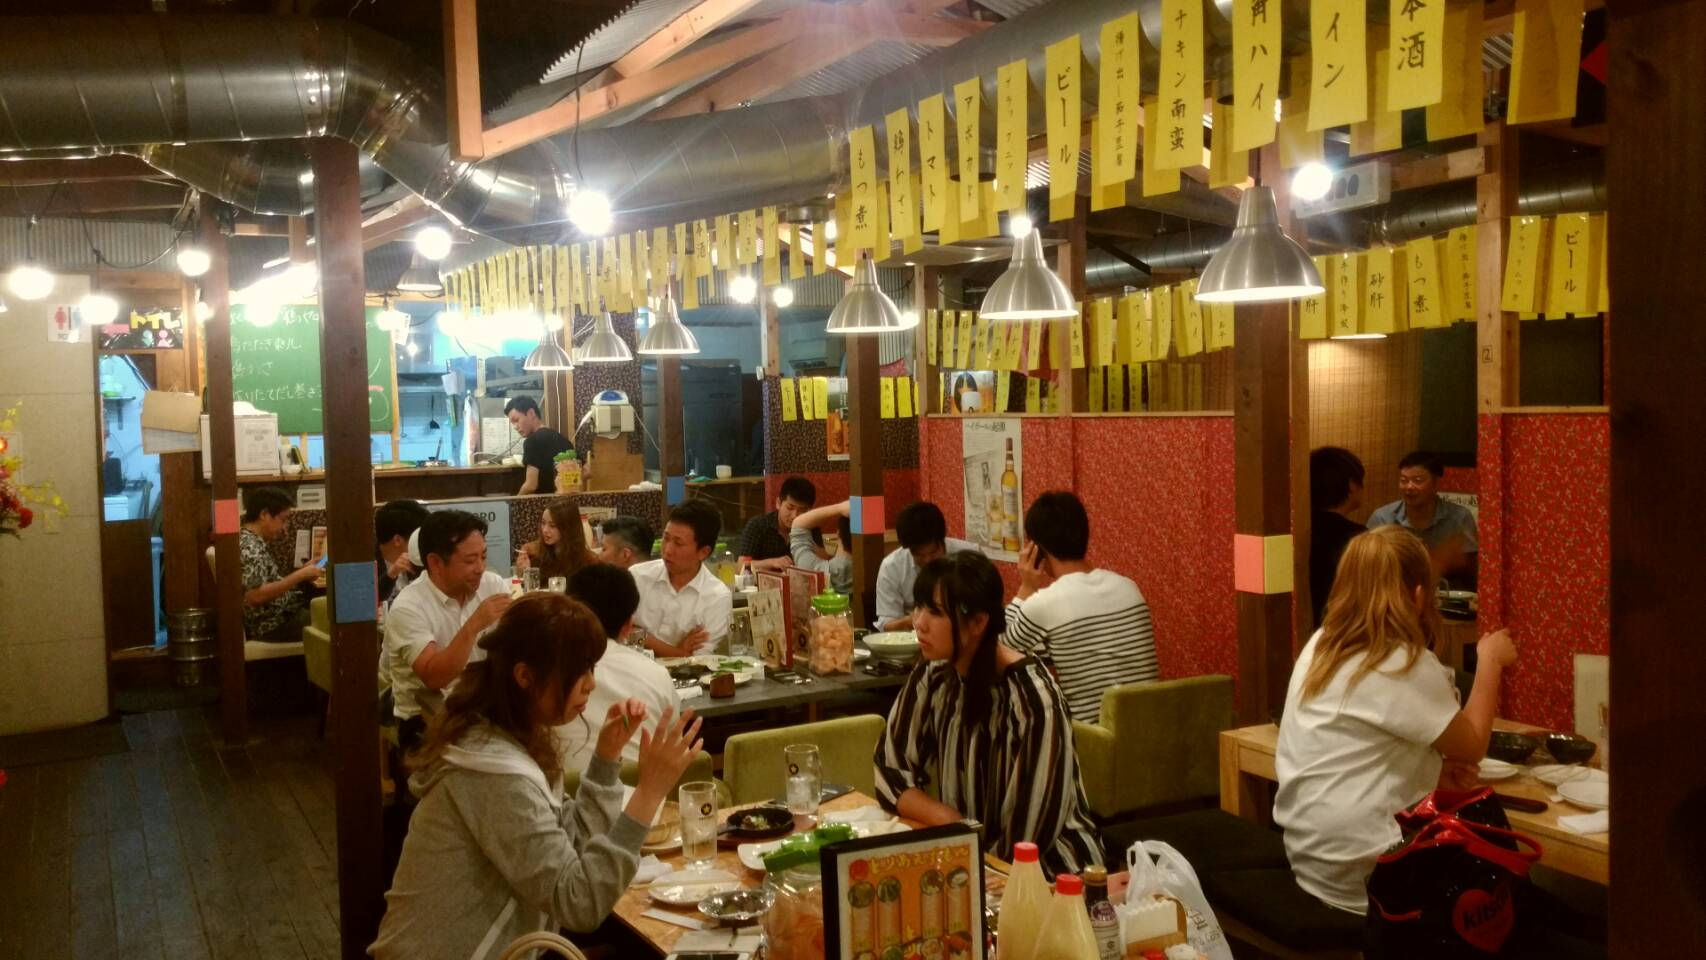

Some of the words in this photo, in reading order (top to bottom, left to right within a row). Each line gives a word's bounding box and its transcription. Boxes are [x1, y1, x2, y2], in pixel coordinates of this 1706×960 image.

[1169, 9, 1188, 151] チキン南蛮
[1250, 0, 1268, 112] 角ハイ
[963, 95, 974, 197] アボカド
[1056, 66, 1072, 165] ビール
[855, 149, 868, 230] もつ煮
[926, 121, 937, 201] トマト
[1369, 272, 1385, 310] 砂肝
[1412, 254, 1430, 314] もつ煮
[1563, 230, 1579, 294] ビール
